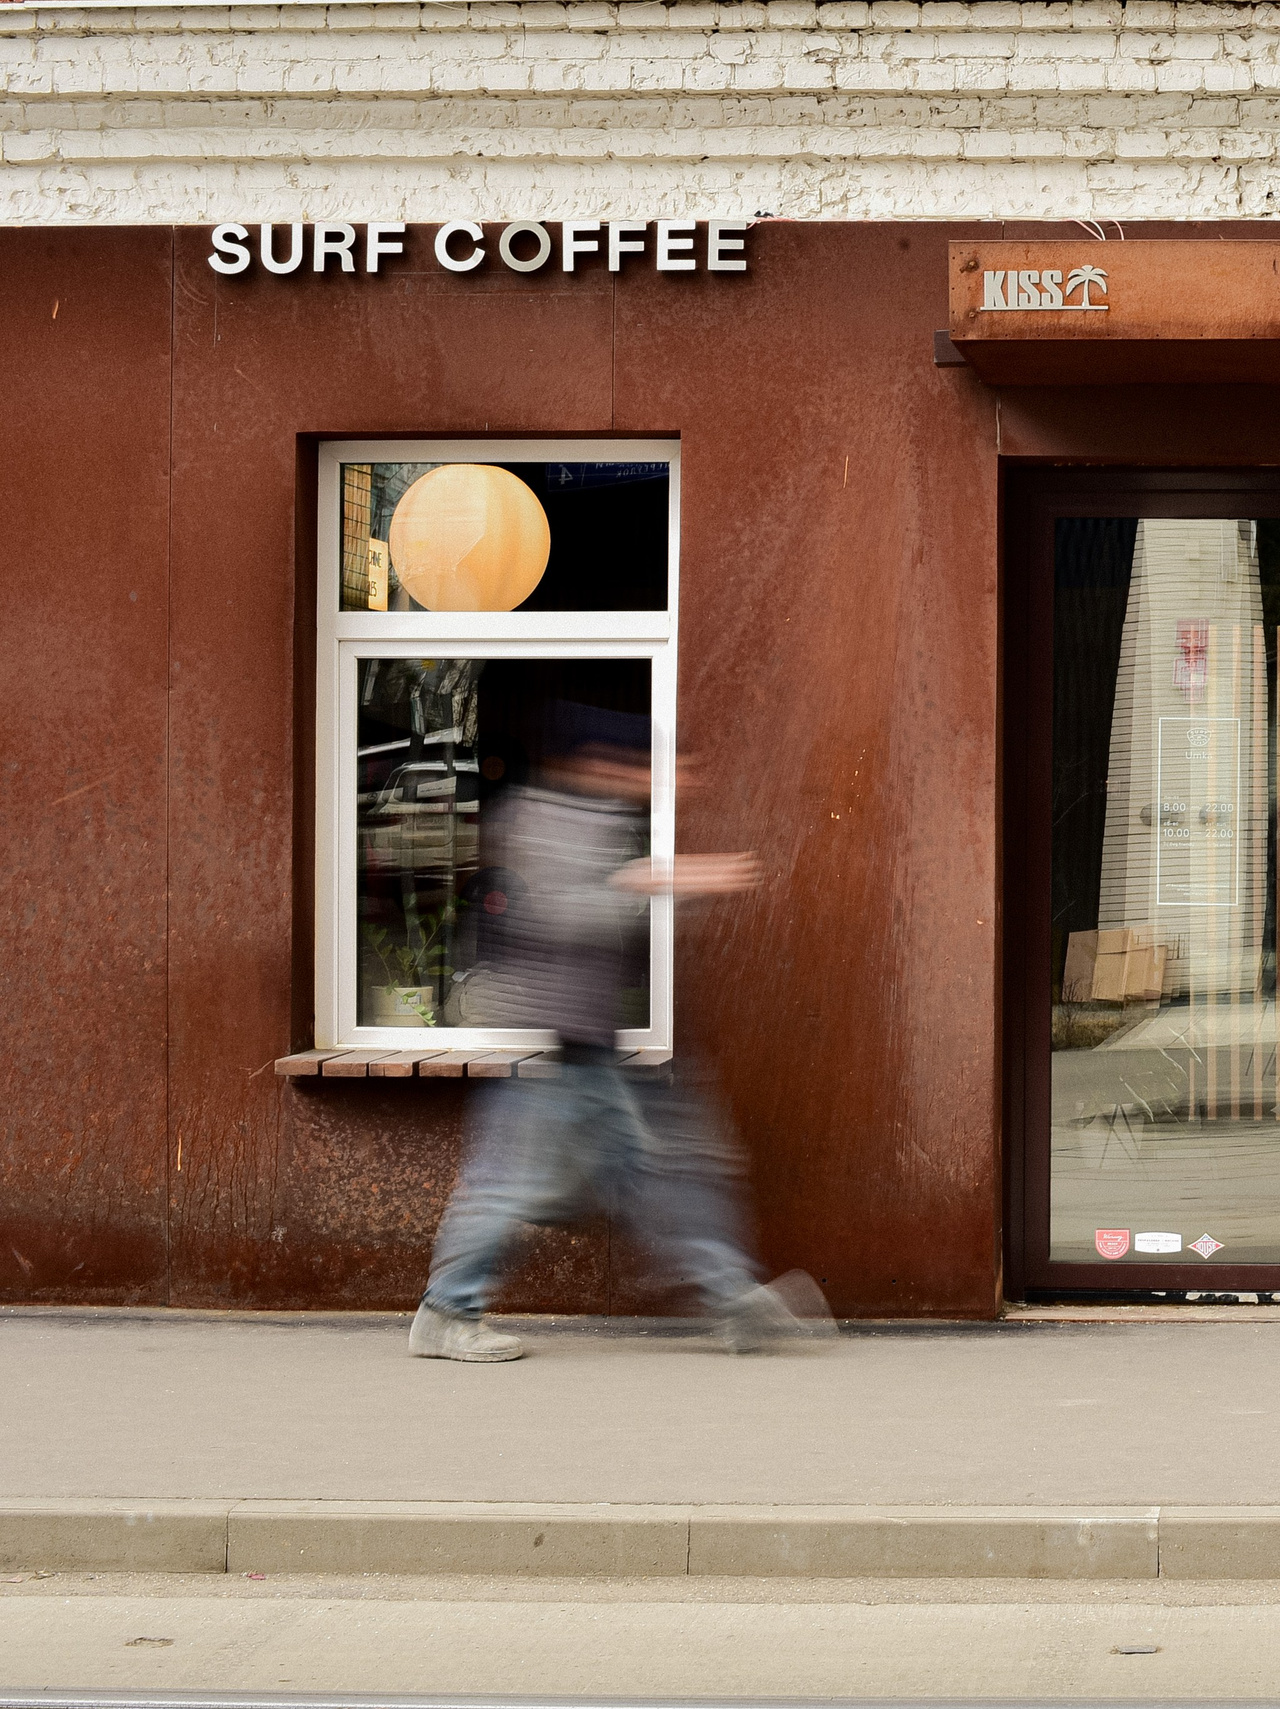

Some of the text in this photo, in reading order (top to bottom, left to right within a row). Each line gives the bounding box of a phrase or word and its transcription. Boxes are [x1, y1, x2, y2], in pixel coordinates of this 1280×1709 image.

[207, 219, 748, 275] SURF COFFEE
[983, 270, 1064, 307] KISS
[1163, 803, 1186, 812] 8.00
[1205, 803, 1234, 813] 22.00
[1163, 828, 1190, 838] 10.00
[1205, 828, 1234, 838] 22.00
